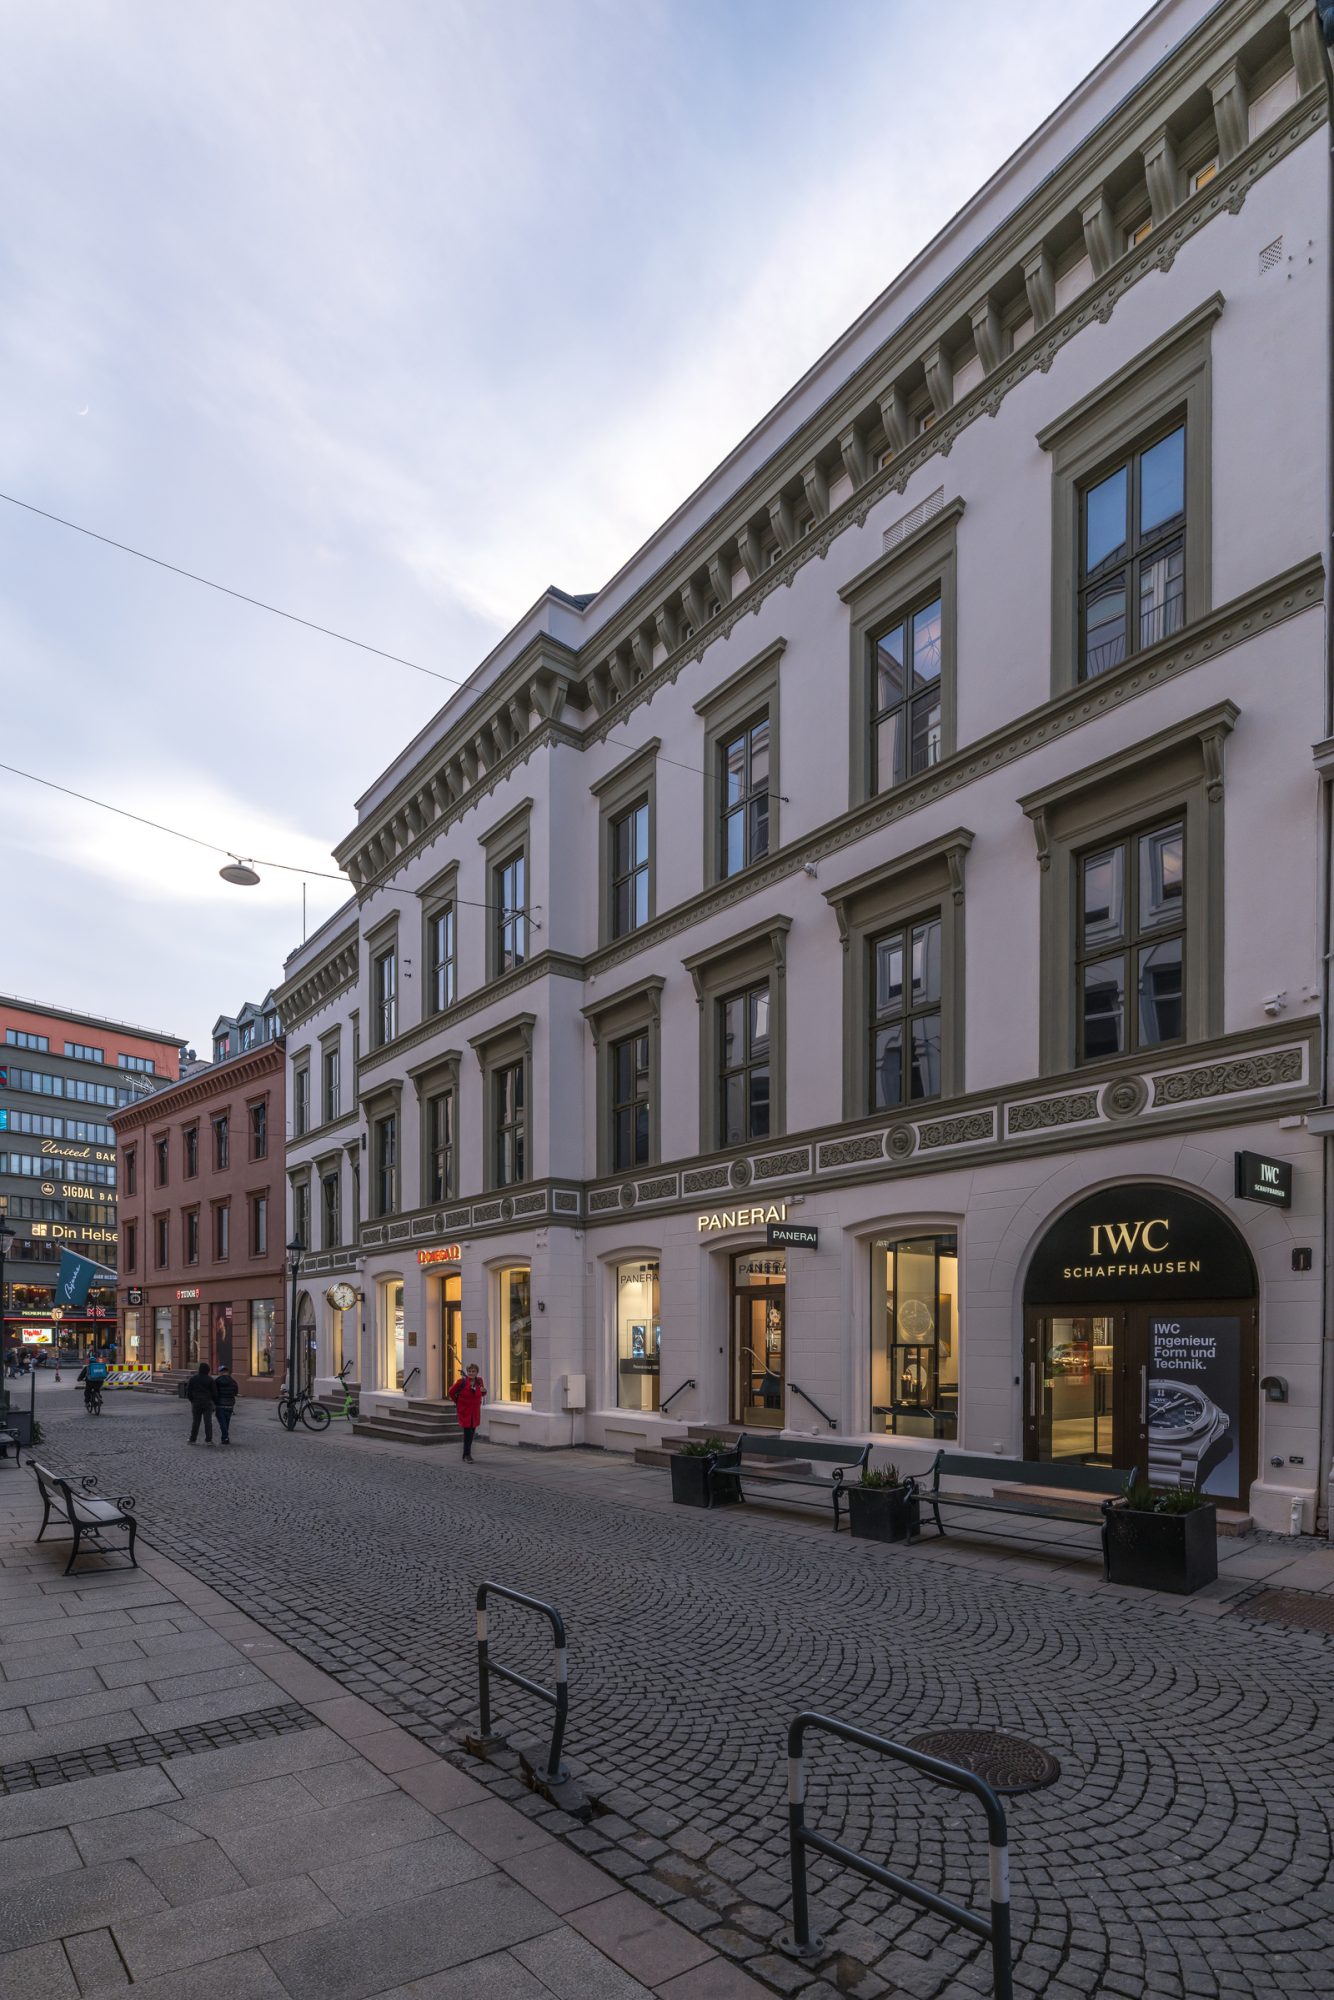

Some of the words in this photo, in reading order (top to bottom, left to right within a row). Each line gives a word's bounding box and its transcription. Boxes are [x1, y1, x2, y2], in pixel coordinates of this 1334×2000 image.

[41, 1140, 90, 1158] United
[1261, 1164, 1279, 1184] IWC
[62, 1185, 94, 1200] SIGDAL
[698, 1204, 787, 1231] PANERAI
[52, 1225, 77, 1238] Din
[82, 1228, 118, 1242] Helse
[772, 1230, 816, 1242] PANERAI
[1090, 1219, 1169, 1256] IWC
[1063, 1260, 1201, 1279] SCHAFFHAUSEN
[181, 1289, 196, 1298] TUDOR
[1154, 1323, 1181, 1334] IWC
[1154, 1335, 1217, 1348] Ingenieur.
[1154, 1347, 1187, 1358] Form
[1190, 1347, 1216, 1358] und
[1154, 1358, 1207, 1370] Technik.
